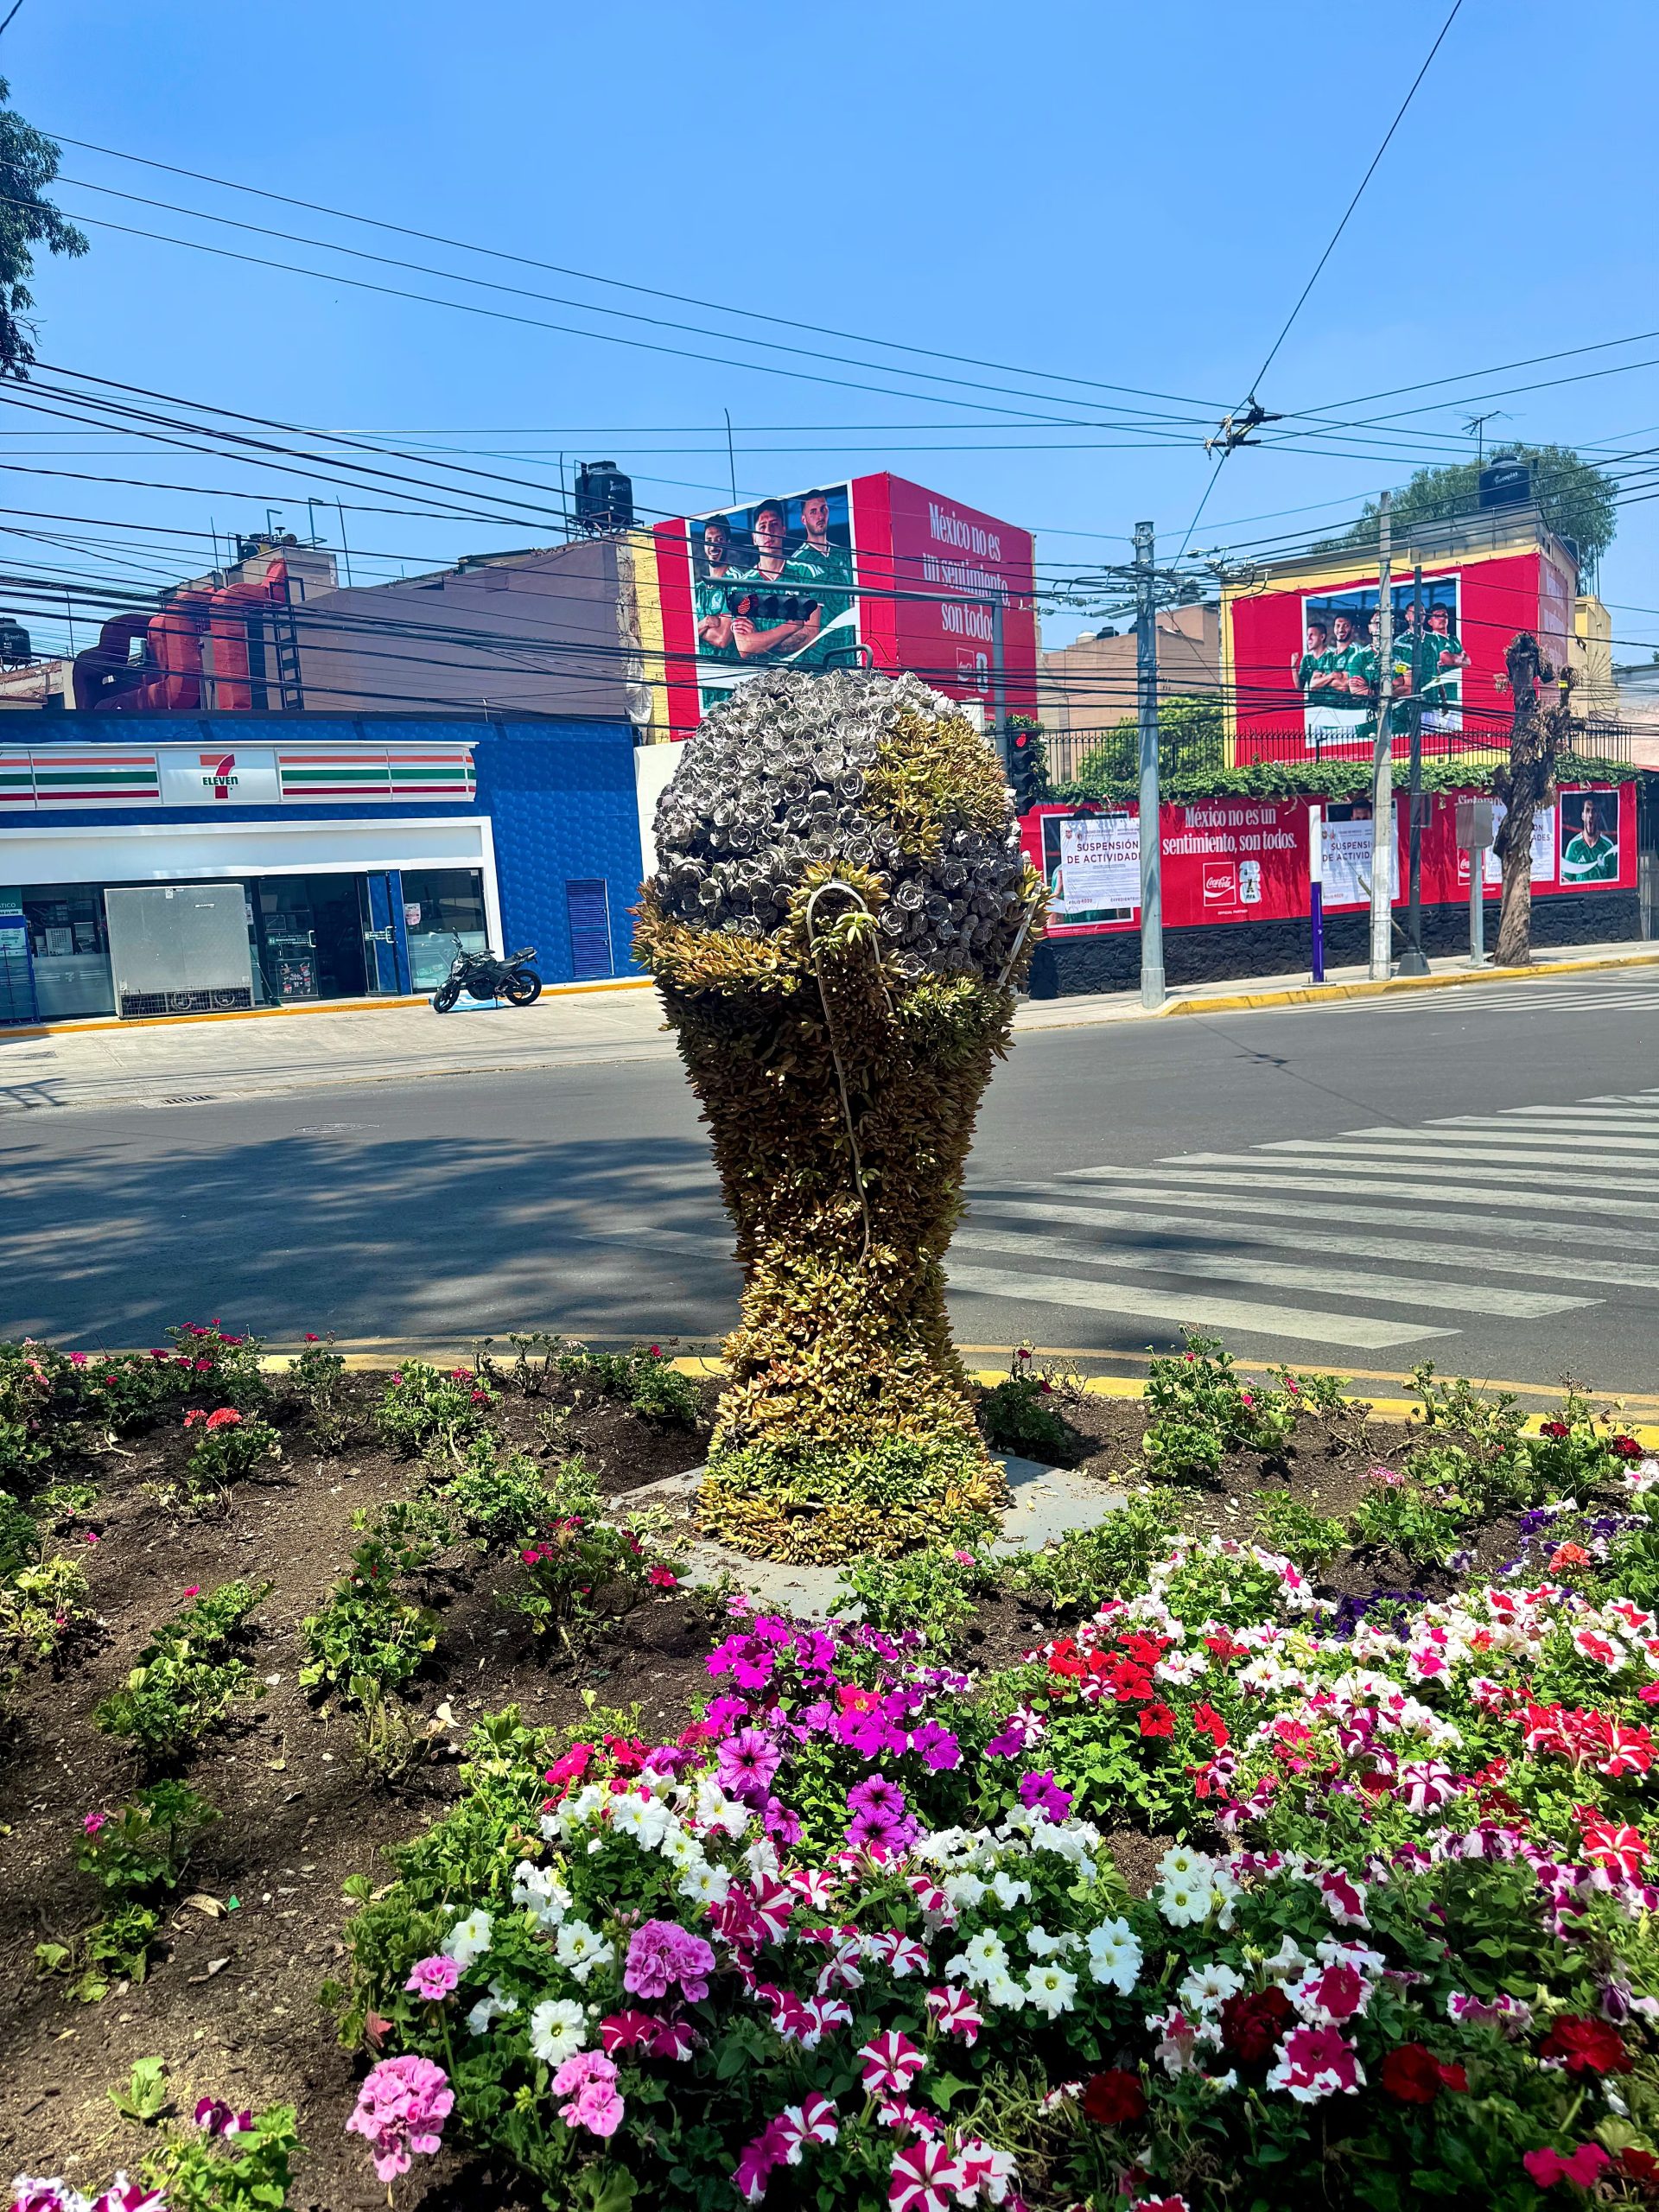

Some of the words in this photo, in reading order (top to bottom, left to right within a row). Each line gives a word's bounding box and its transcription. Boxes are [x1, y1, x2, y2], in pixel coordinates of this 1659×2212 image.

[929, 502, 969, 550] México
[971, 526, 987, 556] no
[988, 533, 1001, 563] es
[941, 603, 963, 635] son
[1185, 806, 1225, 828] México
[1228, 810, 1244, 827] no
[1245, 809, 1259, 825] es
[1261, 808, 1276, 824] un
[1077, 839, 1139, 852] SUSPENSIÓN
[1162, 832, 1237, 855] sentimiento,
[1239, 834, 1261, 851] son
[1262, 828, 1297, 849] todos.
[1331, 841, 1372, 851] SUSPENSI
[1067, 855, 1080, 864] DE
[1084, 852, 1141, 863] ACTIVIDAD
[1322, 854, 1333, 862] DE
[1337, 851, 1372, 861] ACTIVID
